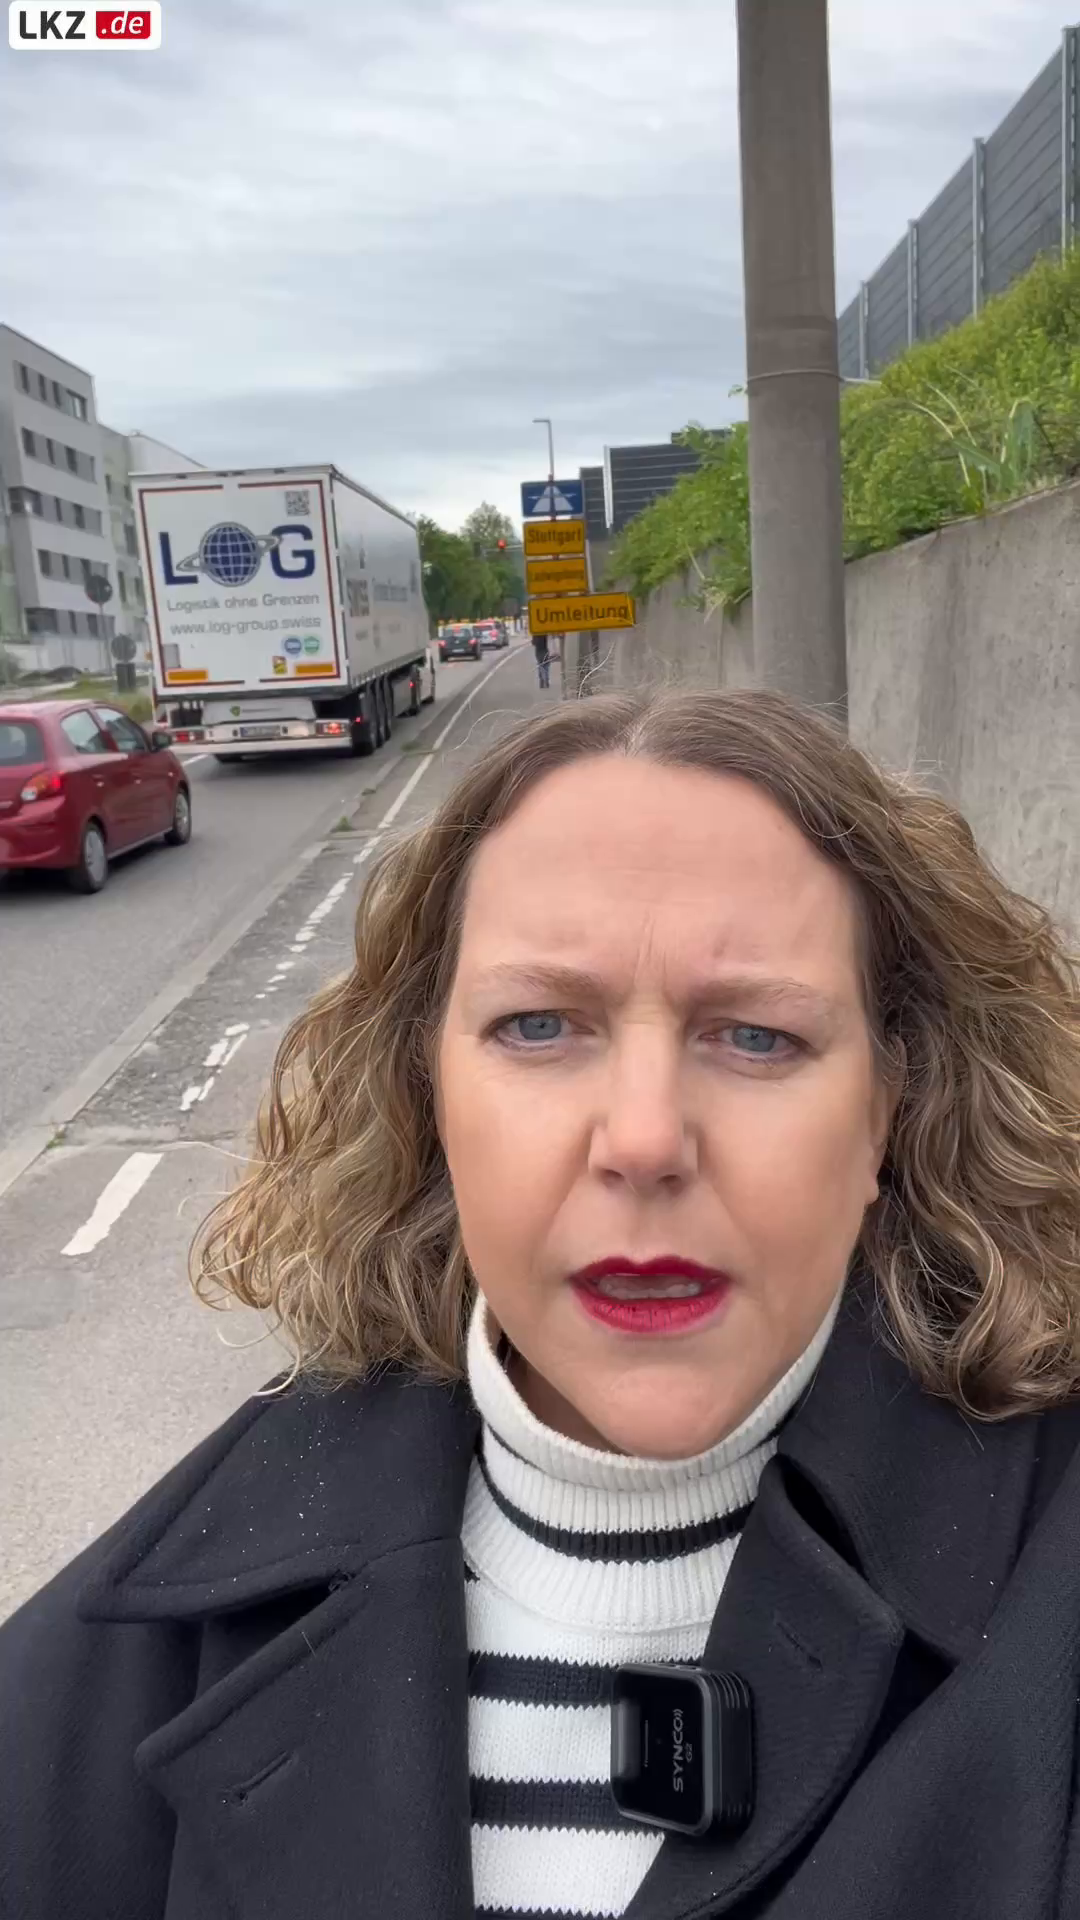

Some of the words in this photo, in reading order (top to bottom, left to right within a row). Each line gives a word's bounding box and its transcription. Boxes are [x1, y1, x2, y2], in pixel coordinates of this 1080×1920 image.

[527, 527, 582, 547] Stuttgart
[167, 597, 220, 614] Logistik
[225, 596, 259, 609] ohne
[262, 593, 320, 607] Grenzen
[536, 604, 629, 624] Umleitung
[170, 616, 322, 636] www.log-group.swiss
[685, 1743, 693, 1763] G2
